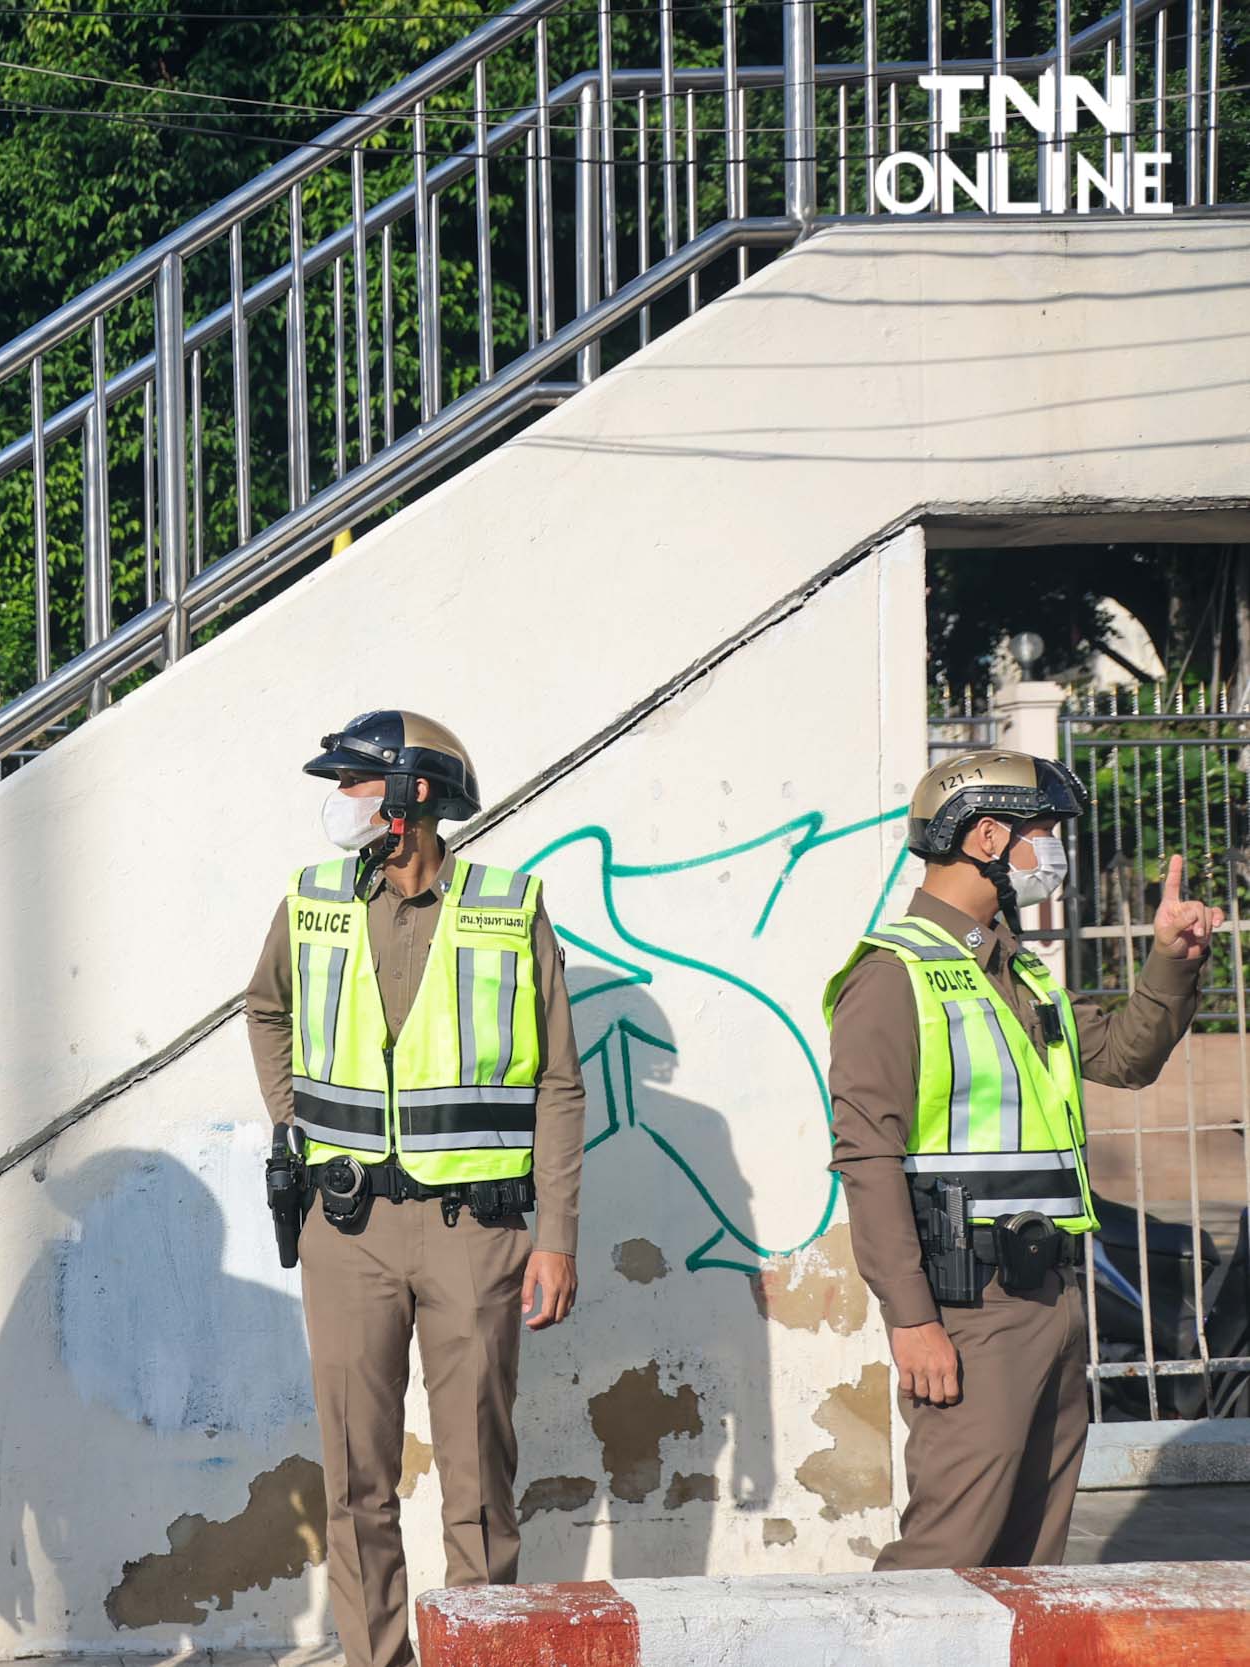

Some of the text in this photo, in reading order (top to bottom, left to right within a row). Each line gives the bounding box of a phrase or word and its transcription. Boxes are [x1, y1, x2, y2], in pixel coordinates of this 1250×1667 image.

[938, 768, 985, 792] 121-1
[297, 910, 352, 934] POLICE
[459, 911, 525, 930] สน.ทุ่งมหาเมฆ
[925, 969, 979, 995] POLICE
